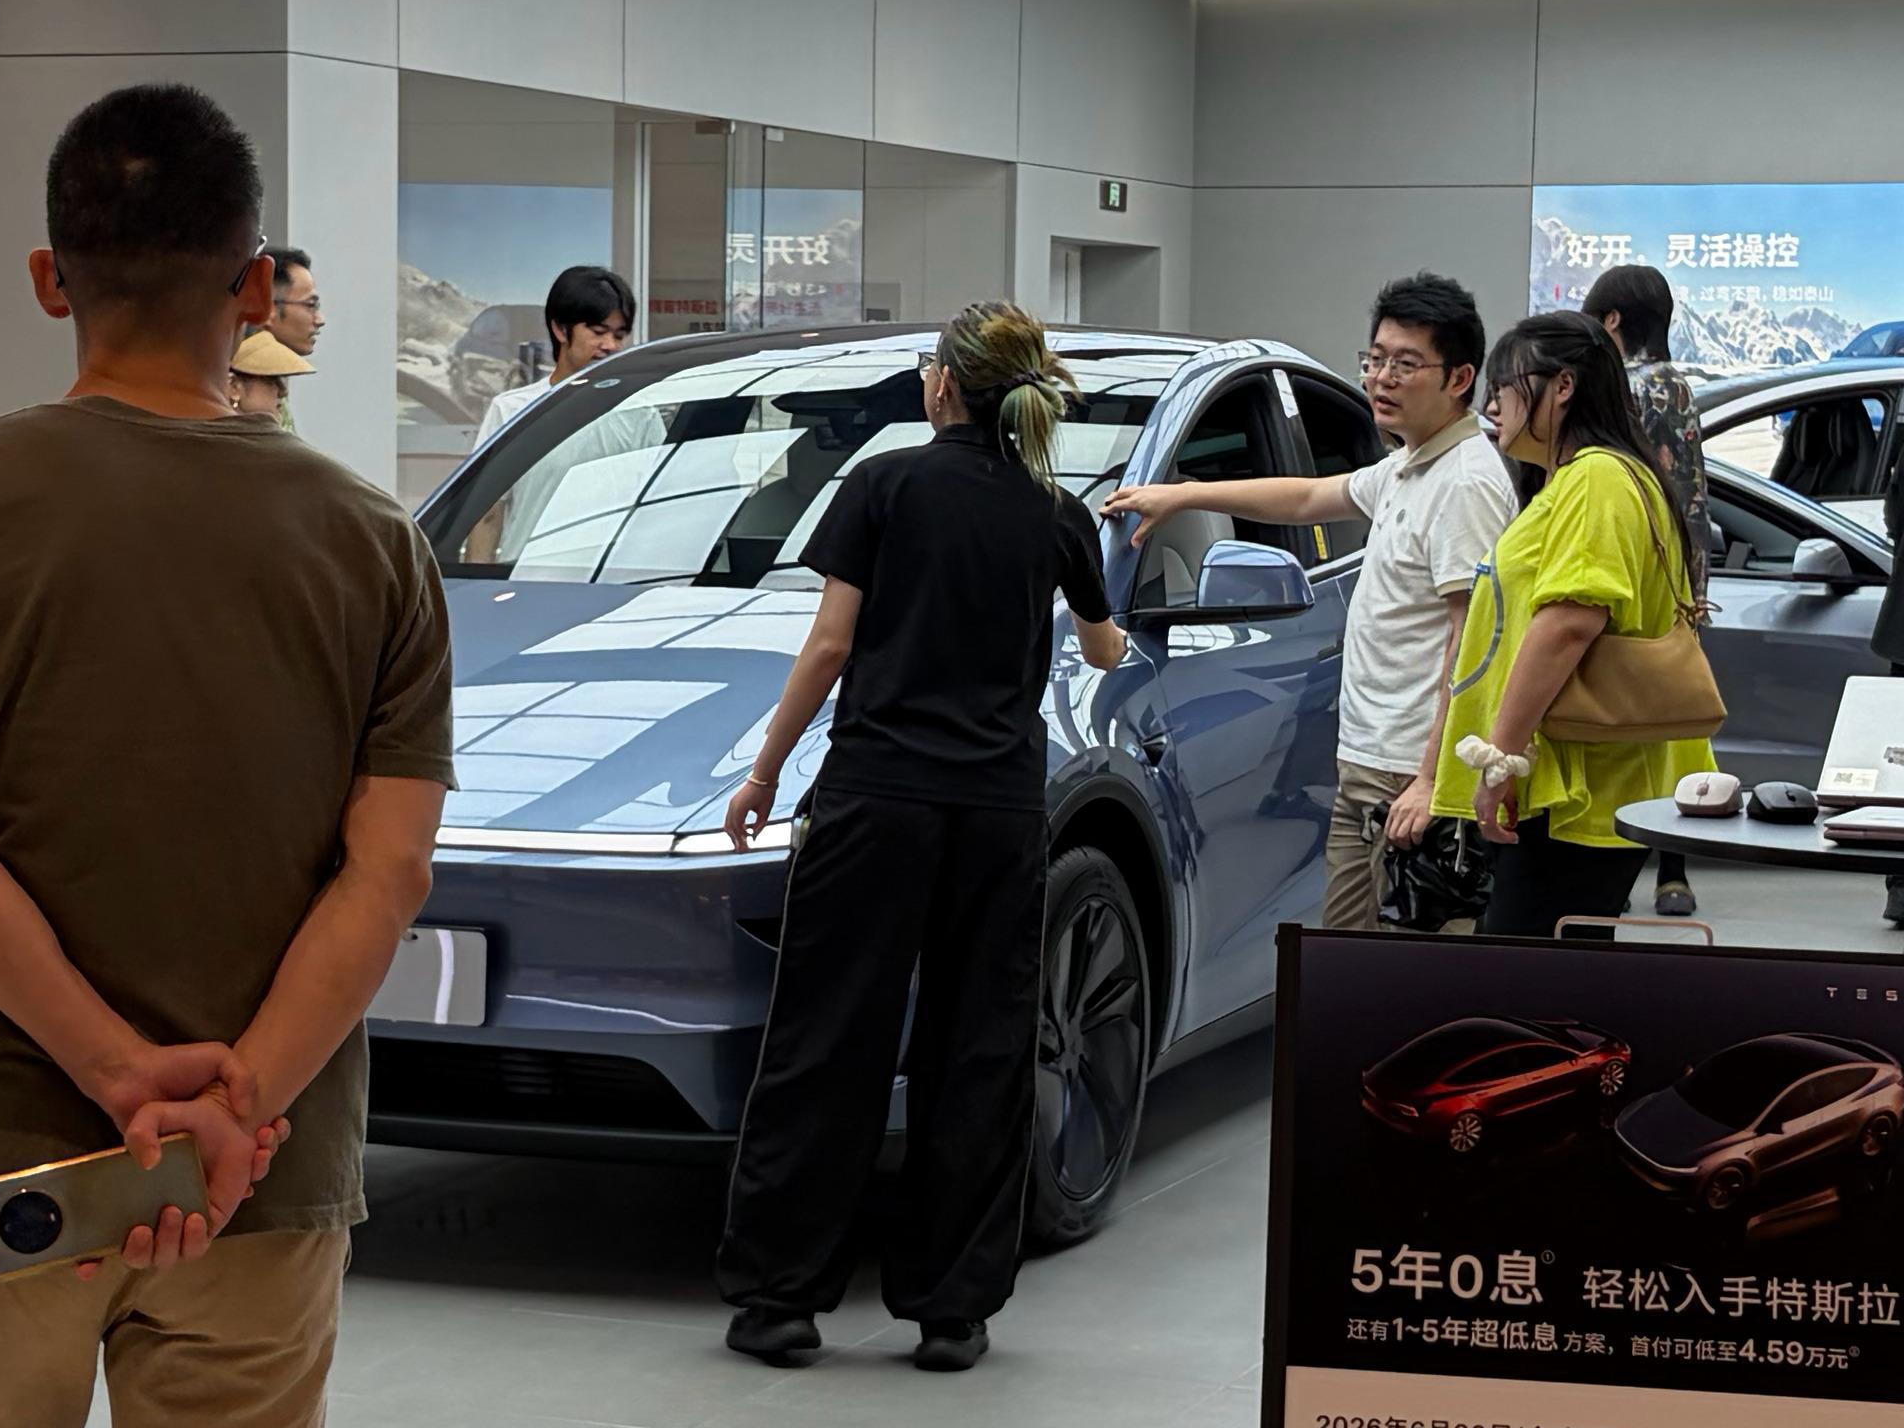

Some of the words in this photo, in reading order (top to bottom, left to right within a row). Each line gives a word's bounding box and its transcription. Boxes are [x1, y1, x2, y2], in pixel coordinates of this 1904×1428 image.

[1566, 232, 1800, 269] 好开，灵活操控
[1582, 1266, 1900, 1326] 轻松入手特斯拉
